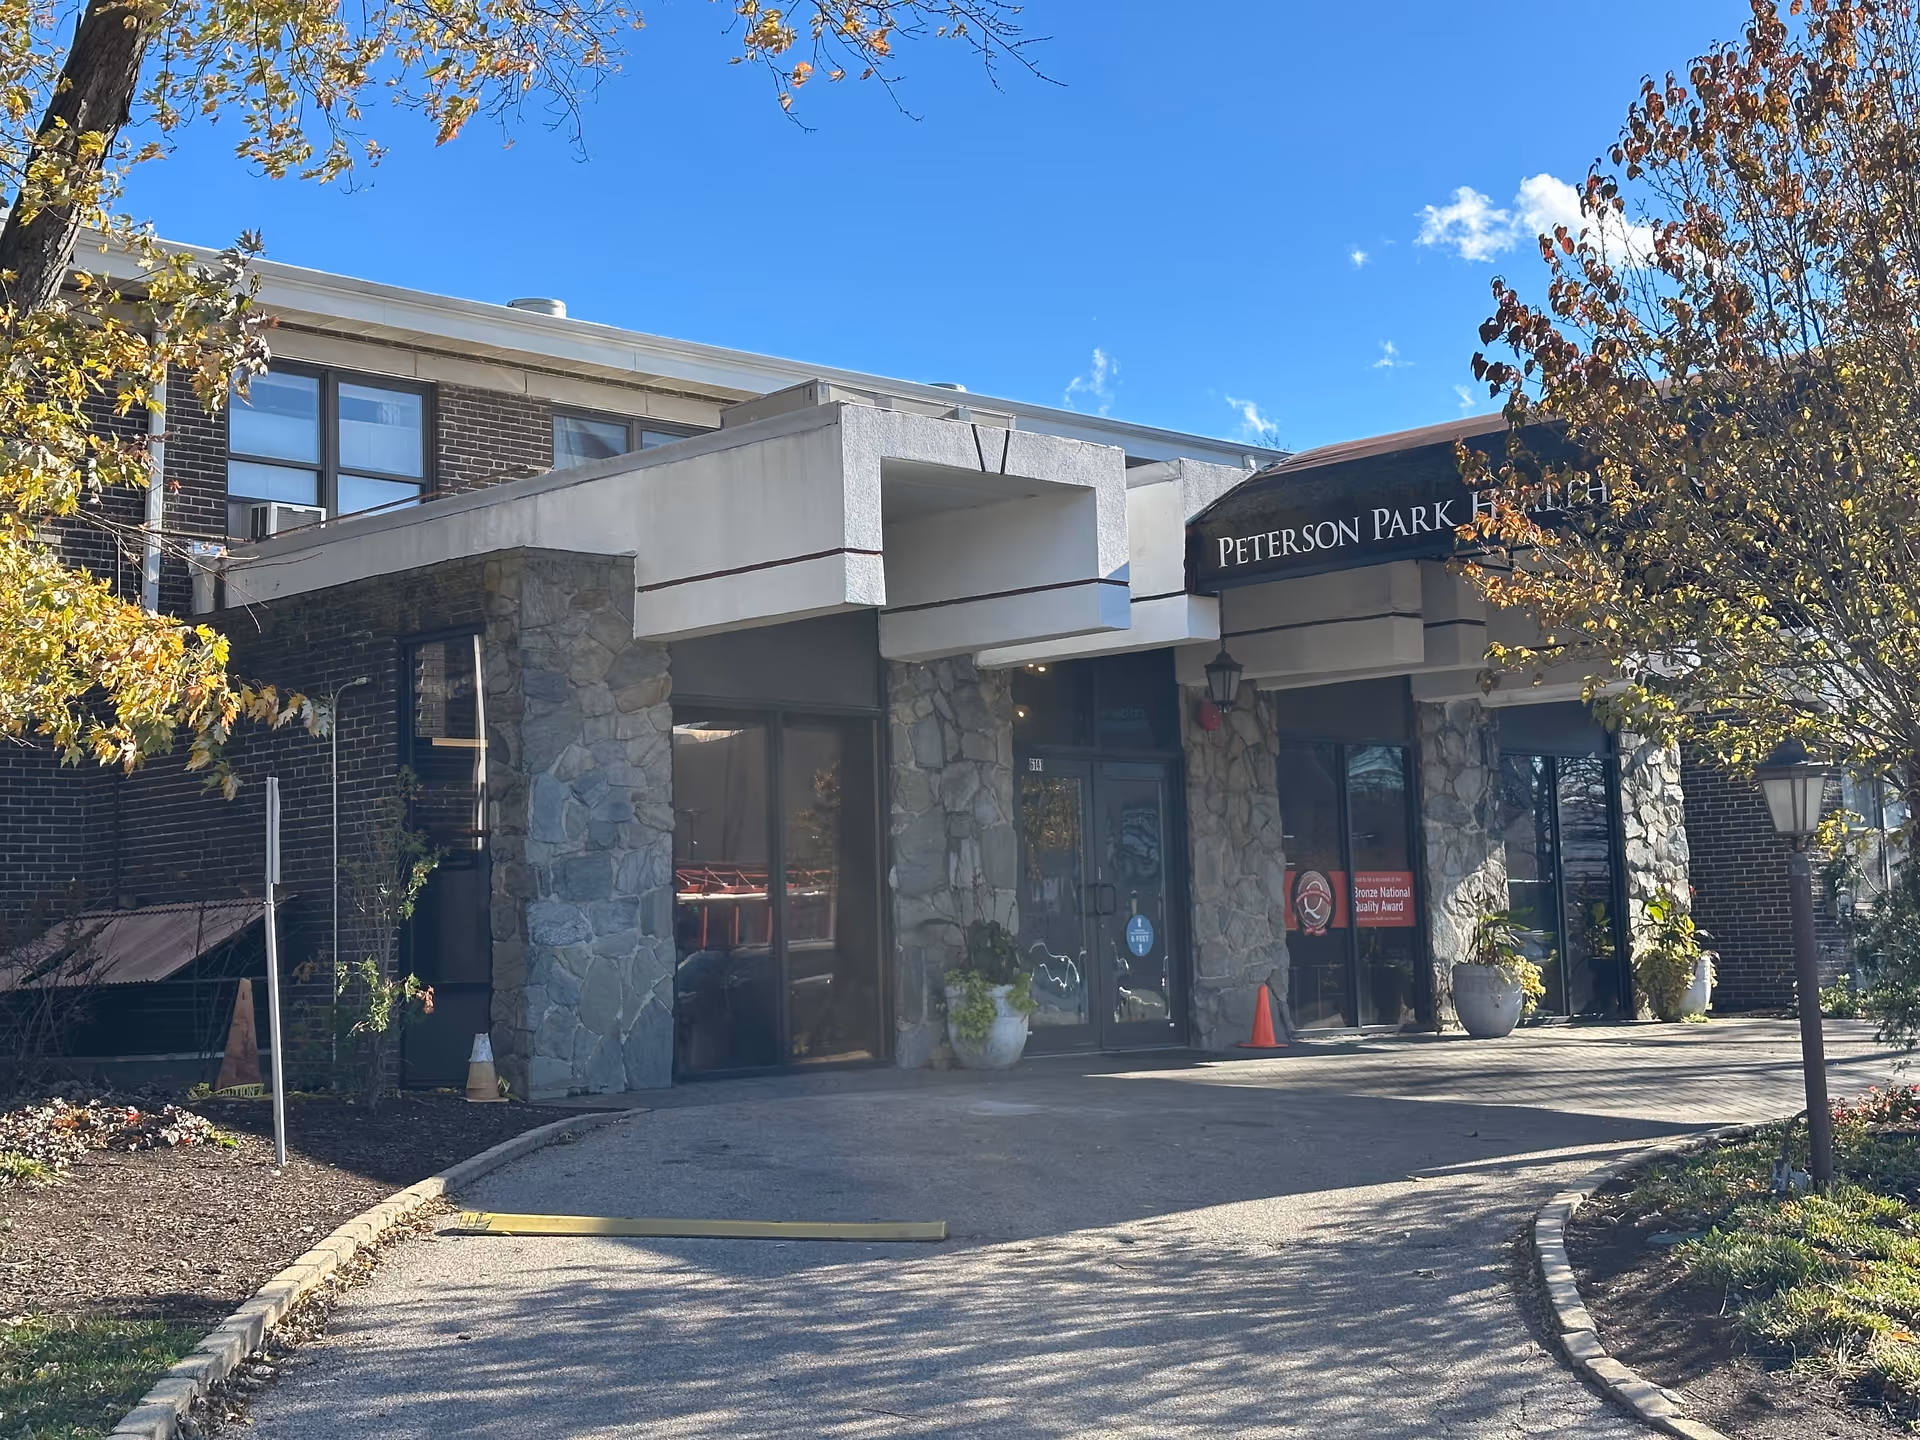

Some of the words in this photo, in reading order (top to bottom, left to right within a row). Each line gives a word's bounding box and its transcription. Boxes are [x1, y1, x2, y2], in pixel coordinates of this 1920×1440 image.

[1217, 516, 1360, 569] PETERSON
[1371, 499, 1457, 541] PARK
[1354, 886, 1378, 898] Bronze
[1380, 886, 1411, 898] National
[1381, 900, 1404, 912] Award
